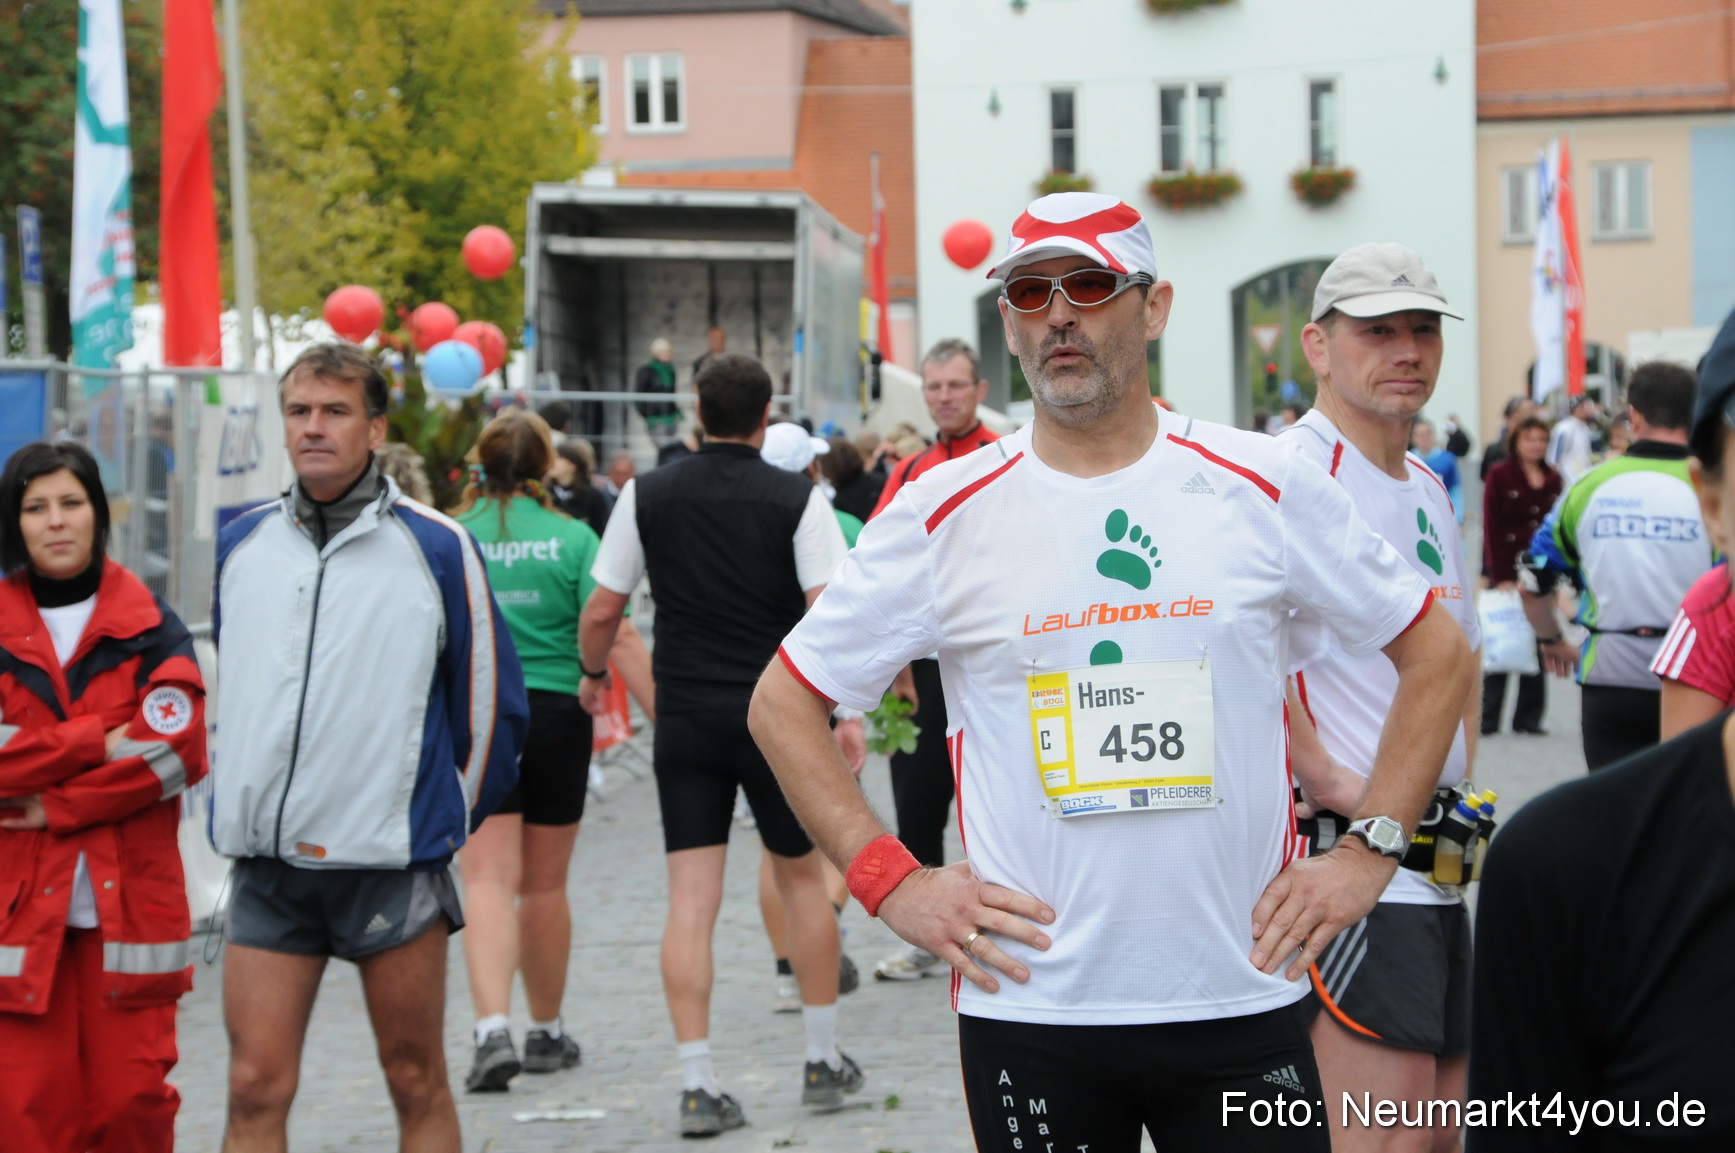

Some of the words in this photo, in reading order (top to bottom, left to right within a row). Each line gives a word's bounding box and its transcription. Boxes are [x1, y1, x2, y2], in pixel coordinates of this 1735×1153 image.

[1180, 486, 1216, 496] adidas
[1593, 513, 1698, 541] BOCK
[1023, 595, 1214, 636] Laufbox.de
[1078, 681, 1145, 710] Hans-
[1040, 730, 1051, 750] C
[1099, 721, 1185, 763] 458
[1150, 786, 1212, 799] PFLEIDERER
[1060, 796, 1103, 810] BOCK
[1151, 799, 1212, 807] AKTIENGESELLSCHAFT
[1263, 1073, 1306, 1094] adidas
